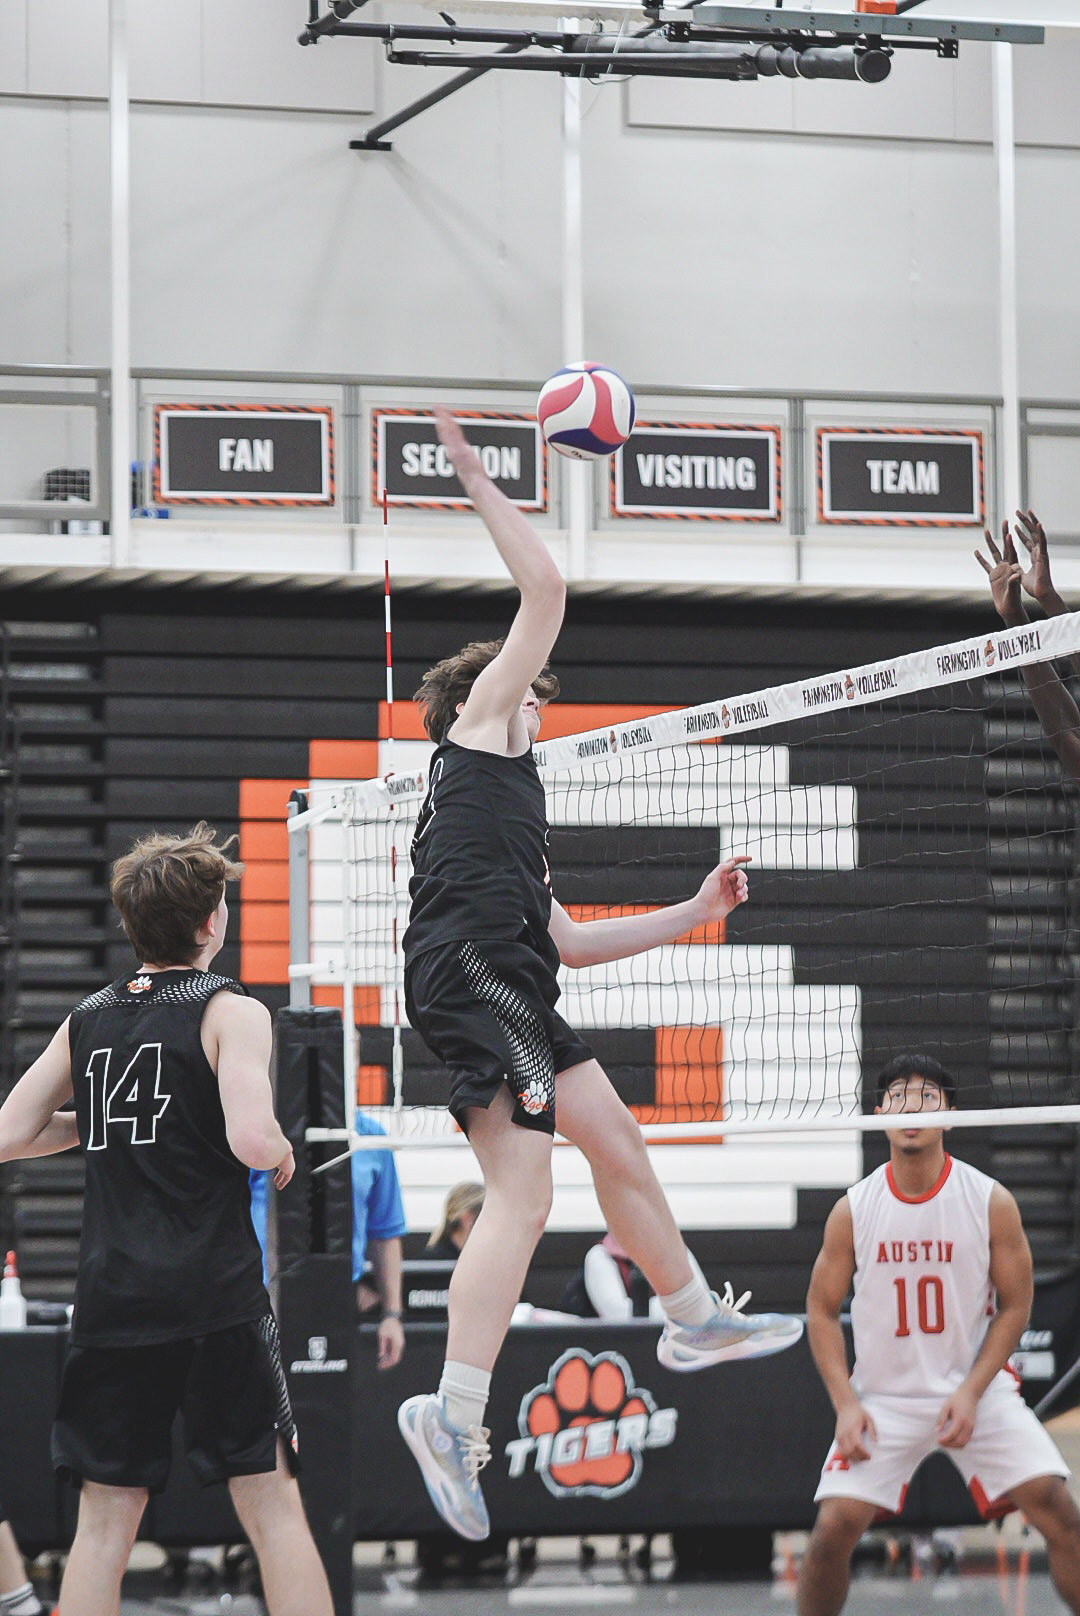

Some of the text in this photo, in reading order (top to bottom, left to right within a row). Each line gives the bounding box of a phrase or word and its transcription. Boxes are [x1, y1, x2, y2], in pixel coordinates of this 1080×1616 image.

[218, 438, 274, 473] FAN
[401, 442, 521, 480] SECON
[635, 453, 757, 491] VISITING
[865, 459, 940, 495] TEAM
[85, 1042, 172, 1151] 14
[876, 1240, 954, 1264] AUSTIN
[893, 1275, 945, 1338] 10
[505, 1407, 679, 1479] TIGERS
